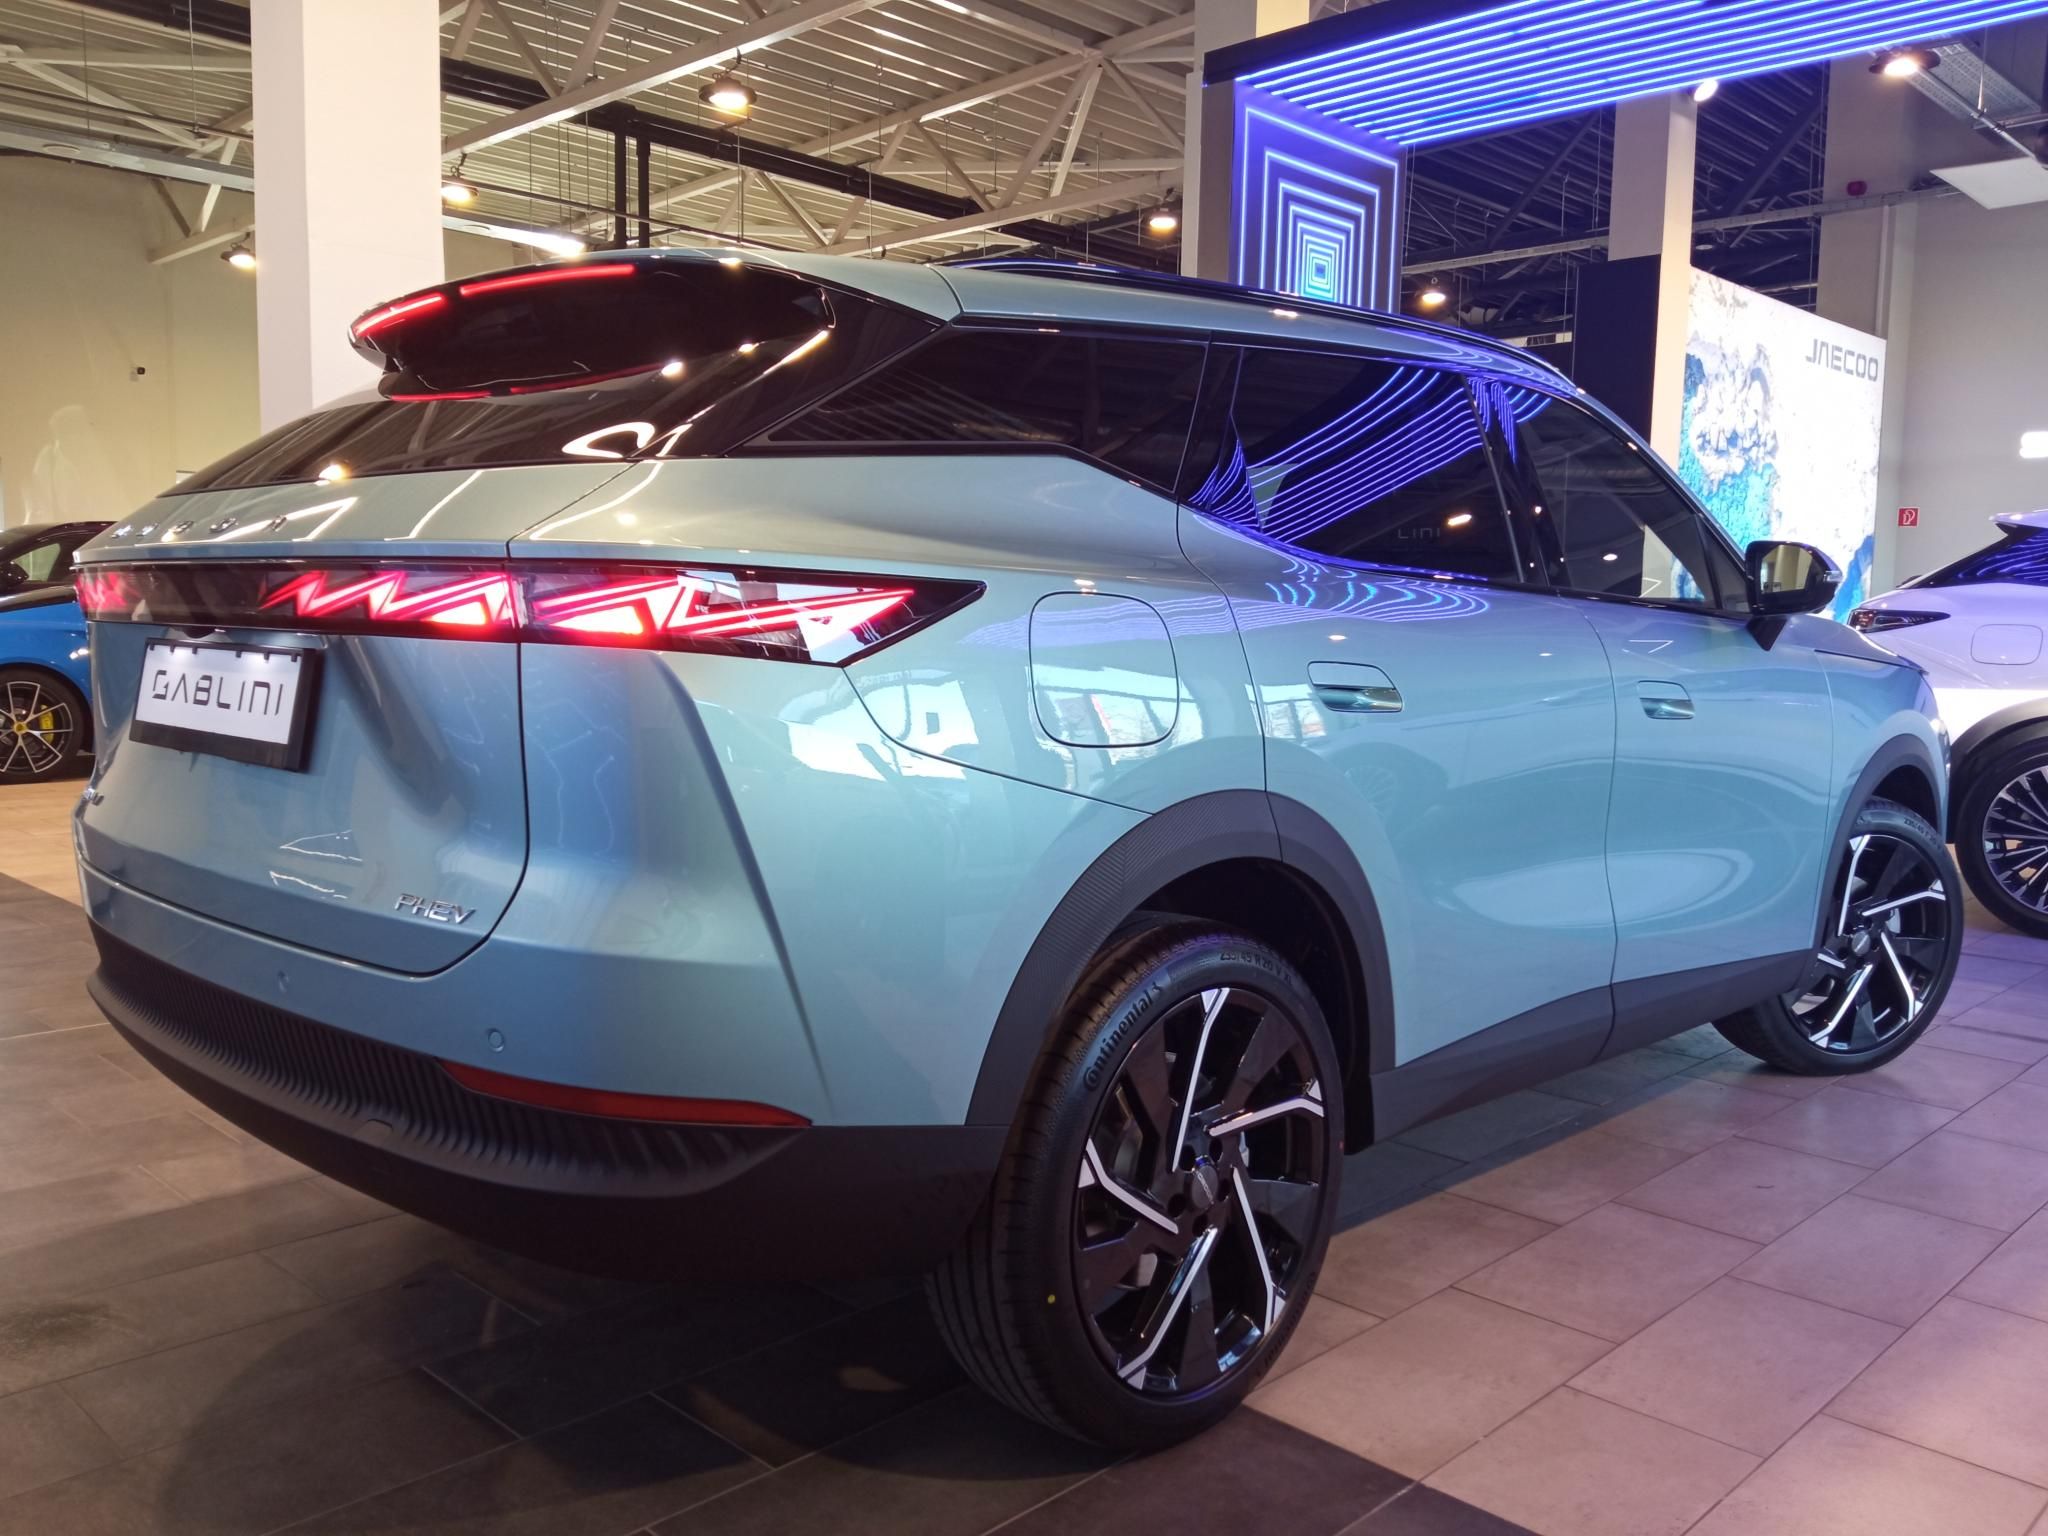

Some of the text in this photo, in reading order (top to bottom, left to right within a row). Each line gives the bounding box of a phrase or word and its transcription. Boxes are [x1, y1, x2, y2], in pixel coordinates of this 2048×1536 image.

[1805, 338, 1879, 382] JAECOO
[151, 669, 283, 716] GABLINI
[394, 893, 477, 924] PHEV
[1083, 990, 1155, 1090] Continental
